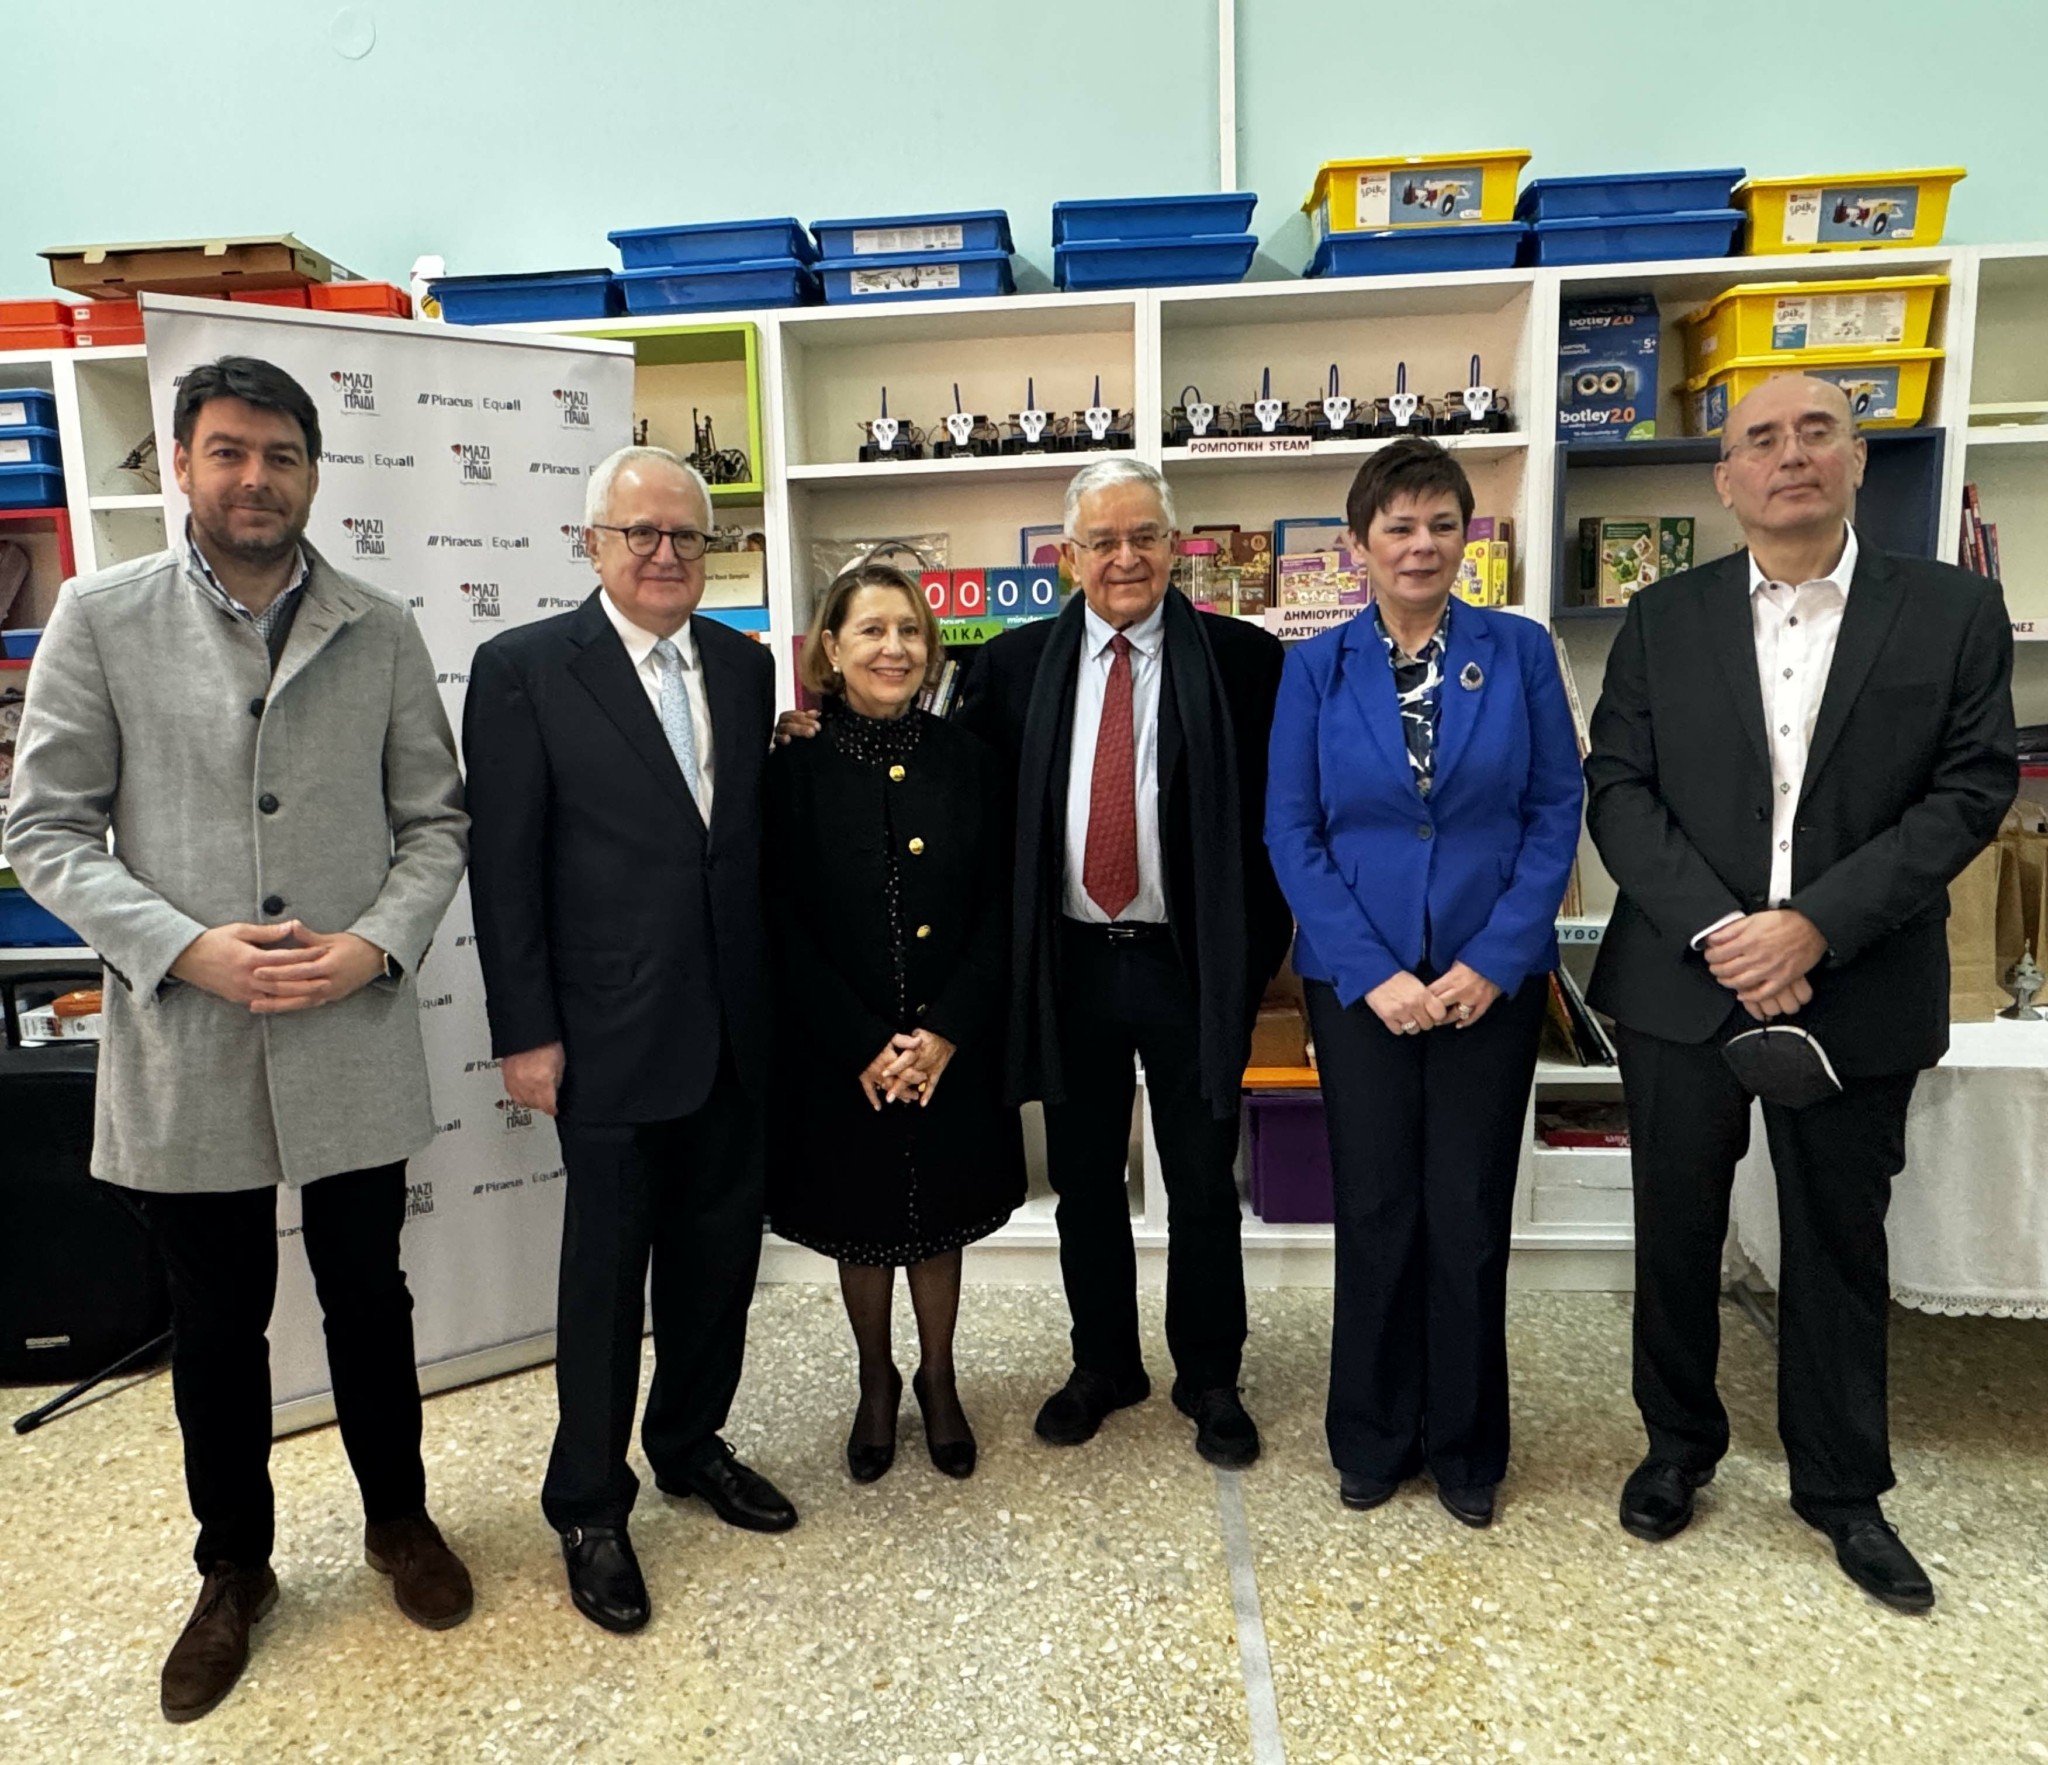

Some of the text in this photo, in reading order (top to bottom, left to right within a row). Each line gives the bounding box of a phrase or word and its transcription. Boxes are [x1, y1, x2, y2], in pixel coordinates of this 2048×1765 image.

[431, 394, 521, 413] Piraeus Equall
[1559, 408, 1611, 424] botley
[1191, 440, 1310, 453] ΡΟΜΠΟΤΙΚΗ STEAM
[320, 451, 414, 469] Piraeus Equall
[542, 463, 580, 475] Piraeus
[440, 537, 530, 550] Piraeus Equall
[410, 597, 424, 608] all
[550, 598, 585, 608] Piraeu
[1284, 608, 1362, 621] ΔΗΜΙΟΥΡΓΙΚΕ
[940, 627, 984, 641] ΛΙΚΑ
[2011, 622, 2035, 633] ΝΕΣ
[1556, 929, 1599, 940] ΥΘΟ
[435, 1119, 461, 1135] quall
[485, 1178, 524, 1194] Piraeus
